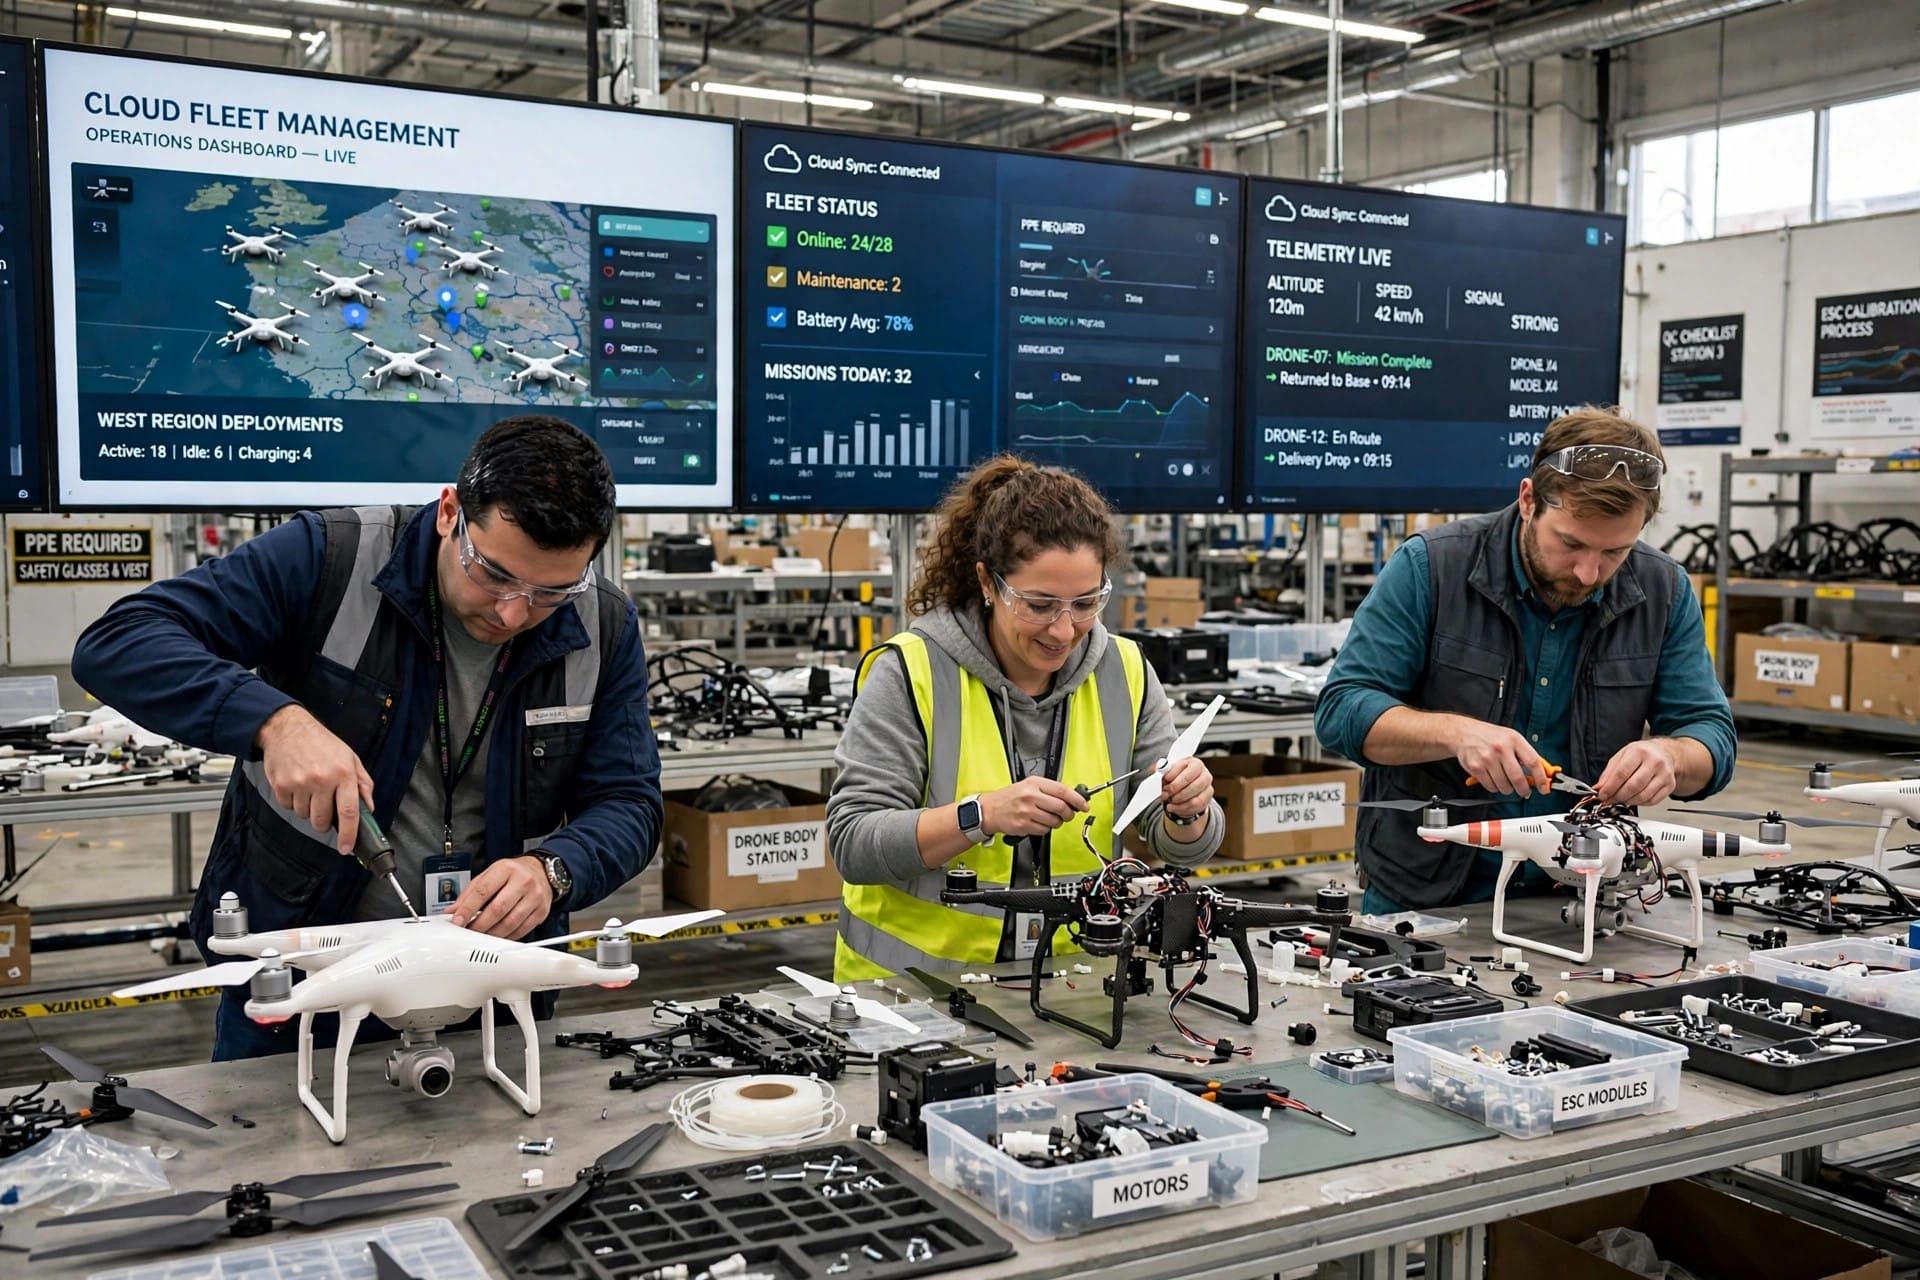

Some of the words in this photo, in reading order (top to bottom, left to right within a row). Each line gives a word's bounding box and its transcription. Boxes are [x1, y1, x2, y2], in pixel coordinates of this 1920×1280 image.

[84, 91, 180, 121] CLOUD
[190, 102, 269, 130] FLEET
[278, 111, 460, 148] MANAGEMENT
[86, 127, 193, 150] OPERATIONS
[198, 137, 297, 159] DASHBOARD
[324, 149, 357, 165] LIVE
[807, 154, 843, 171] Cloud
[845, 158, 877, 175] Sync:
[879, 161, 941, 180] Connected
[766, 192, 814, 212] FLEET
[817, 196, 879, 218] STATUS
[1020, 218, 1040, 232] PPE
[1300, 204, 1330, 219] Cloud
[1331, 207, 1357, 223] Sync:
[1358, 210, 1410, 227] Connected
[796, 230, 847, 250] Online:
[850, 234, 893, 253] 24/28
[1266, 239, 1356, 264] TELEMETRY
[1358, 247, 1392, 267] LIVE
[796, 270, 888, 292] Maintenance:
[891, 276, 902, 293] 2
[1267, 274, 1325, 294] ALTITUDE
[1375, 282, 1413, 300] SPEED
[1268, 298, 1305, 316] 120m
[1464, 289, 1505, 307] SIGNAL
[1374, 305, 1392, 322] 42
[1393, 307, 1424, 324] km/h
[1821, 305, 1843, 322] ESC
[1844, 298, 1920, 320] CALIBRATION
[796, 310, 847, 333] Battery
[850, 313, 880, 334] Avg:
[884, 315, 914, 332] 78%
[1510, 314, 1559, 333] STRONG
[1820, 321, 1874, 340] PROCESS
[1662, 329, 1679, 348] QC
[1266, 347, 1332, 364] DRONE-07:
[1336, 351, 1379, 367] Mission
[1380, 353, 1433, 372] Complete
[1670, 345, 1715, 363] STATION
[1716, 344, 1725, 360] 3
[764, 363, 837, 381] MISSIONS
[840, 366, 891, 383] TODAY:
[894, 368, 912, 384] 32
[1510, 356, 1544, 373] DRONE
[1280, 370, 1330, 386] Returned
[1331, 373, 1343, 387] to
[1345, 373, 1371, 388] Base
[1381, 375, 1411, 390] 09:14
[1509, 378, 1544, 393] MODEL
[1544, 379, 1558, 393] X4
[1508, 404, 1550, 419] BATTERY
[97, 412, 147, 428] WEST
[151, 413, 217, 430] REGION
[222, 414, 344, 433] DEPLOYMENTS
[1264, 428, 1329, 444] DRONE-12:
[1332, 430, 1347, 445] En
[1349, 430, 1382, 446] Route
[1508, 432, 1531, 446] LIPO
[98, 444, 145, 459] Active:
[150, 444, 167, 459] 18
[182, 445, 210, 459] Idle:
[214, 445, 223, 460] 6
[238, 446, 301, 464] Charging:
[302, 447, 312, 460] 4
[1278, 451, 1323, 470] Delivery
[1324, 452, 1351, 470] Drop
[1363, 453, 1392, 468] 09:15
[1507, 454, 1530, 469] LIPO
[24, 533, 58, 553] PPE
[61, 533, 143, 554] REQUIRED
[19, 562, 60, 579] SAFETY
[62, 562, 110, 579] GLASSES
[111, 562, 120, 578] &
[121, 562, 149, 578] VEST
[1258, 792, 1305, 809] BATTERY
[1307, 788, 1341, 804] PACKS
[1277, 809, 1300, 824] LIPO
[1303, 807, 1316, 822] 6S
[735, 831, 780, 849] DRONE
[783, 827, 818, 845] BODY
[746, 849, 797, 866] STATION
[801, 848, 809, 861] 3
[1561, 1093, 1585, 1112] ESC
[1588, 1081, 1648, 1106] MODULES
[1113, 1173, 1189, 1204] MOTORS
